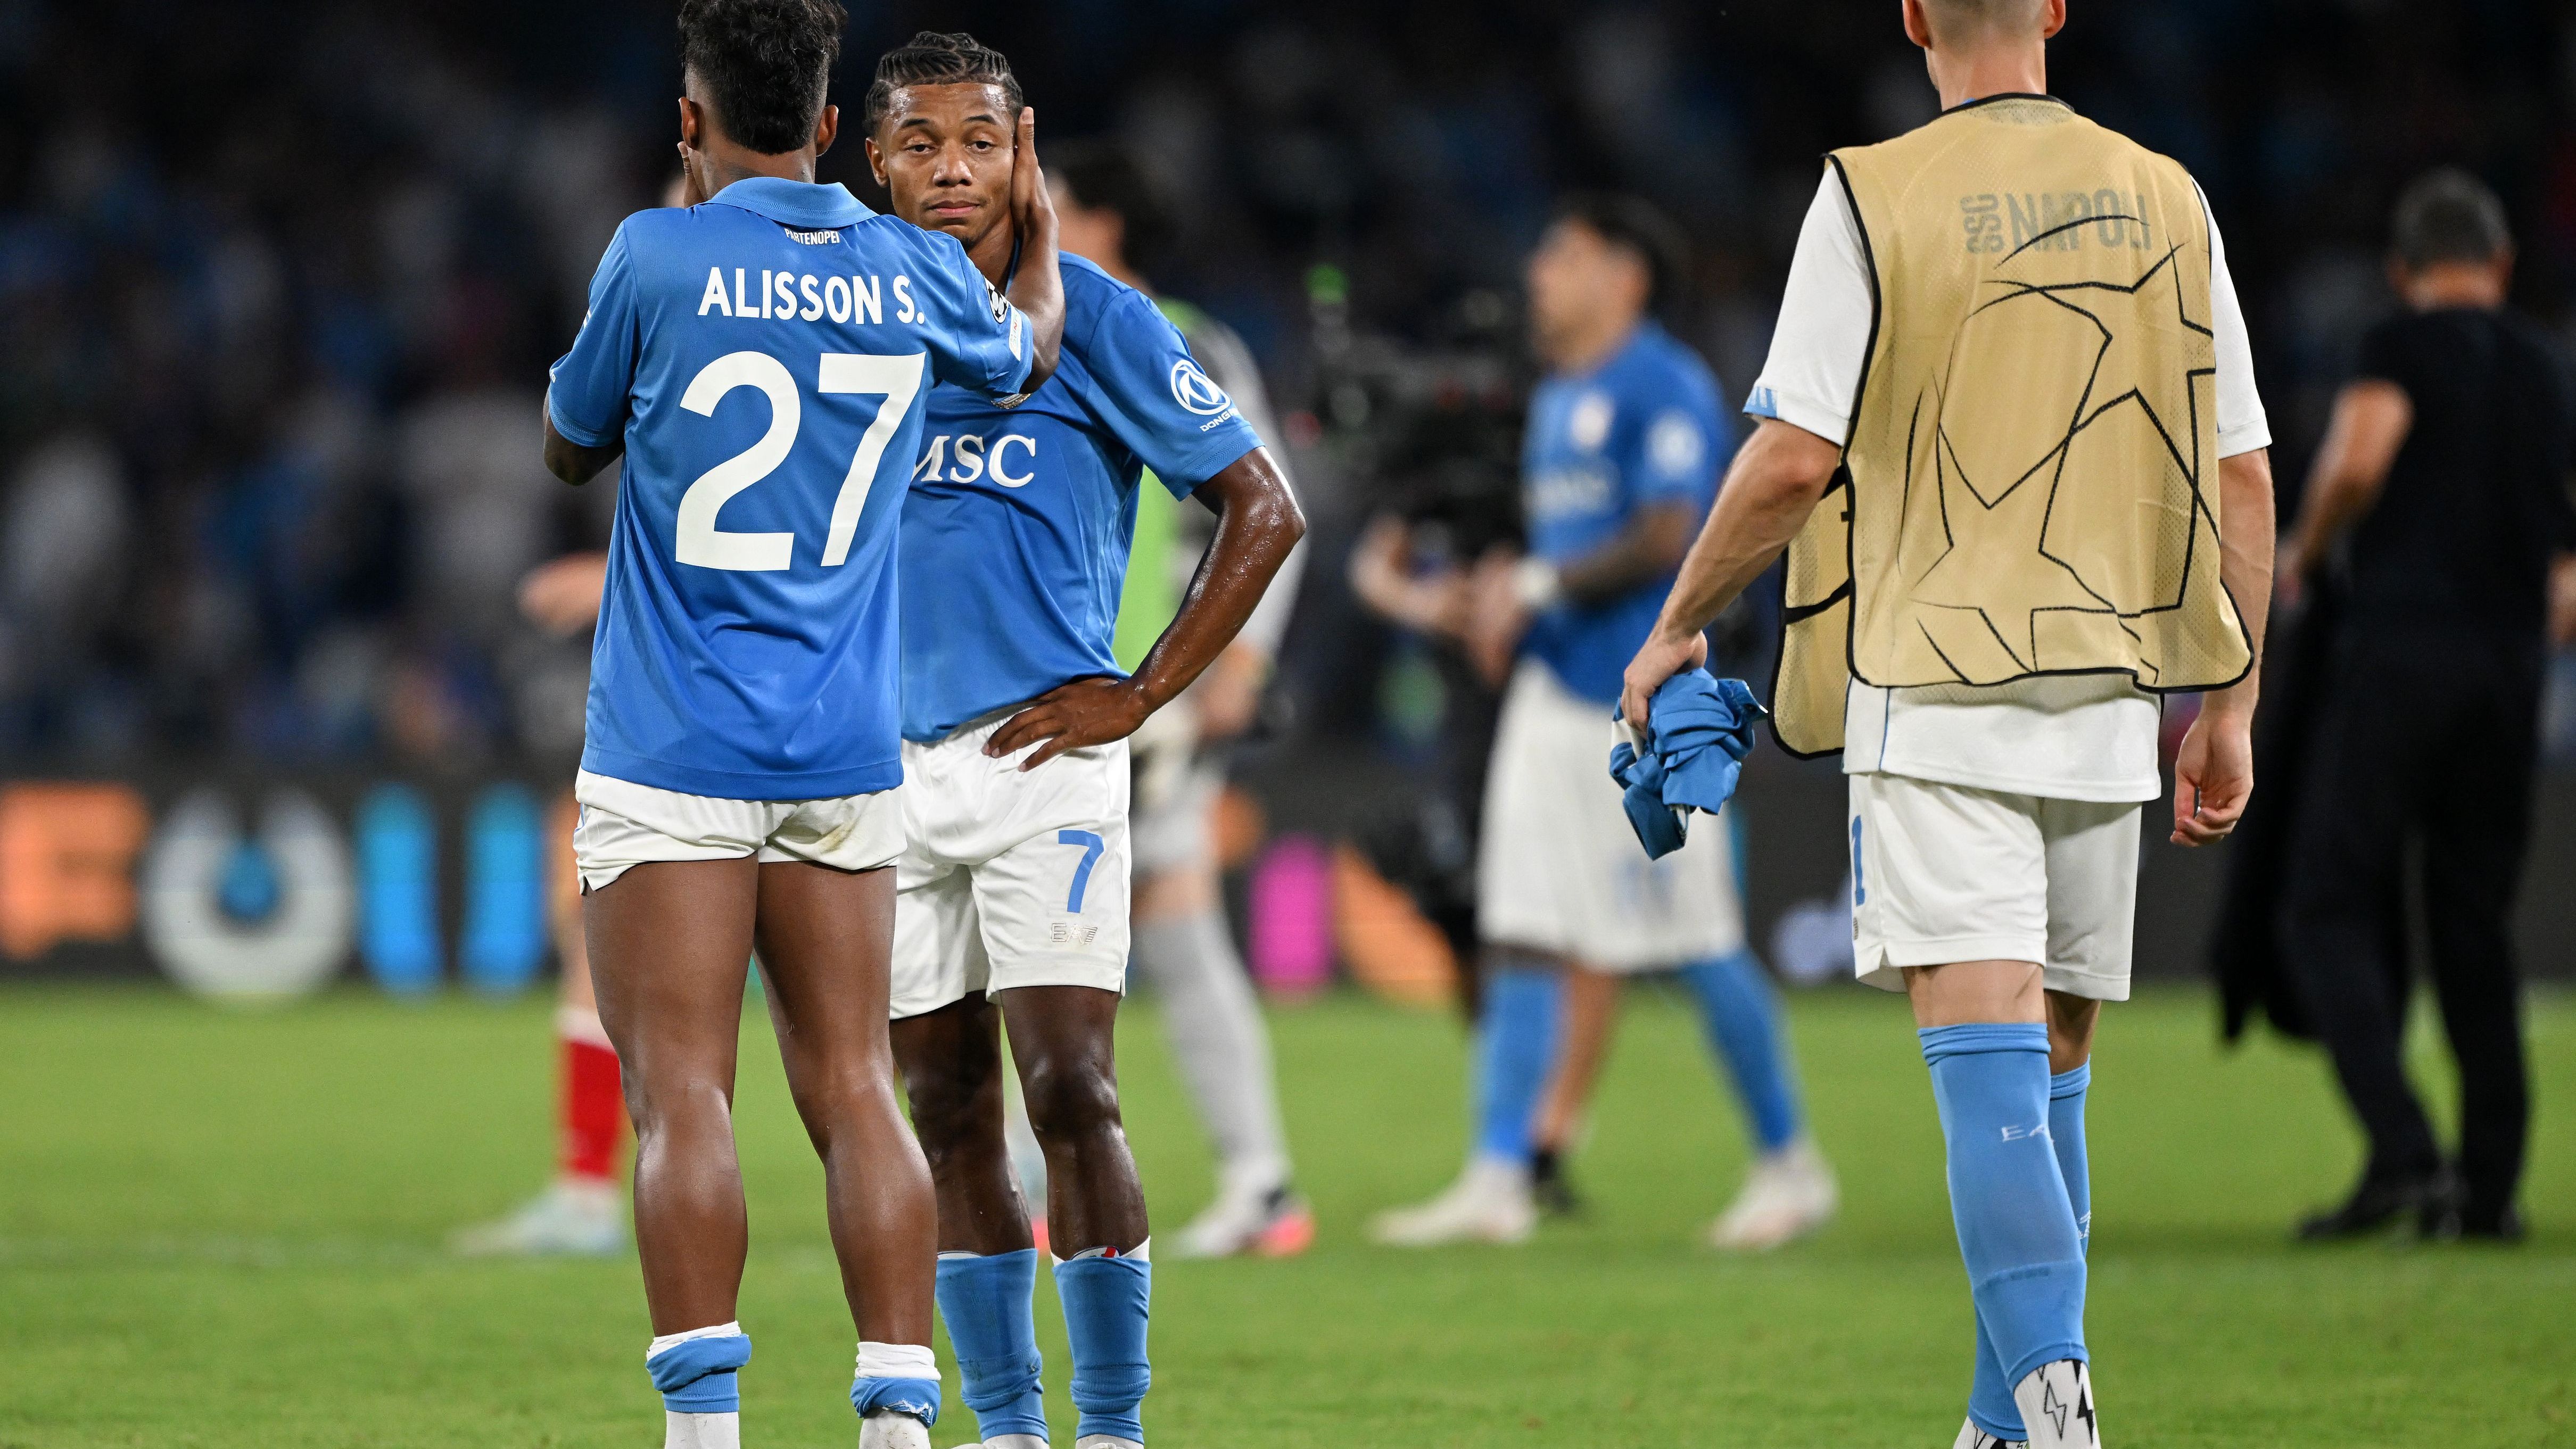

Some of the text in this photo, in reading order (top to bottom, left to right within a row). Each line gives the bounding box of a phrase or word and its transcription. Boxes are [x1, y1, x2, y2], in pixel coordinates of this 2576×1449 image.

[784, 228, 840, 245] PARTENOPEI
[698, 267, 925, 325] ALISSON S.
[675, 351, 926, 571] 27
[1059, 830, 1104, 913] 7
[1051, 923, 1098, 945] EA7
